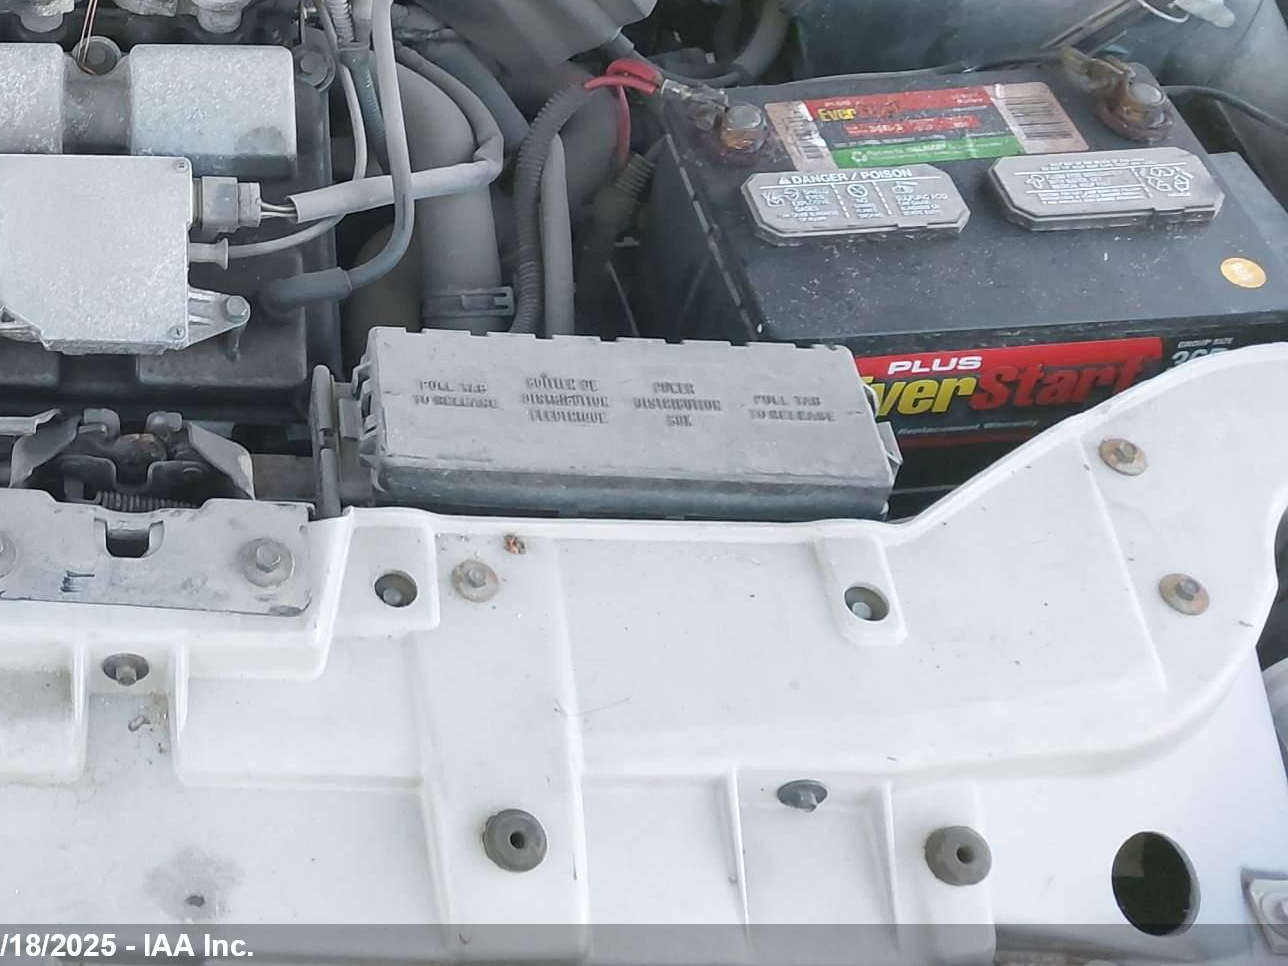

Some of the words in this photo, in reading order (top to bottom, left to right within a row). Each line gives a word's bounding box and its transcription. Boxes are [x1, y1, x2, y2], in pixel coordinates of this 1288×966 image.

[791, 172, 848, 184] DANGER
[860, 168, 913, 179] POISON
[887, 355, 983, 375] PLUS
[419, 380, 454, 392] PULL
[862, 355, 1155, 417] verStart
[632, 397, 721, 412] DISTRIBUTION
[753, 395, 789, 406] PULL
[793, 396, 821, 407] TAB
[749, 409, 767, 420] TO
[769, 410, 836, 422] RELEASE
